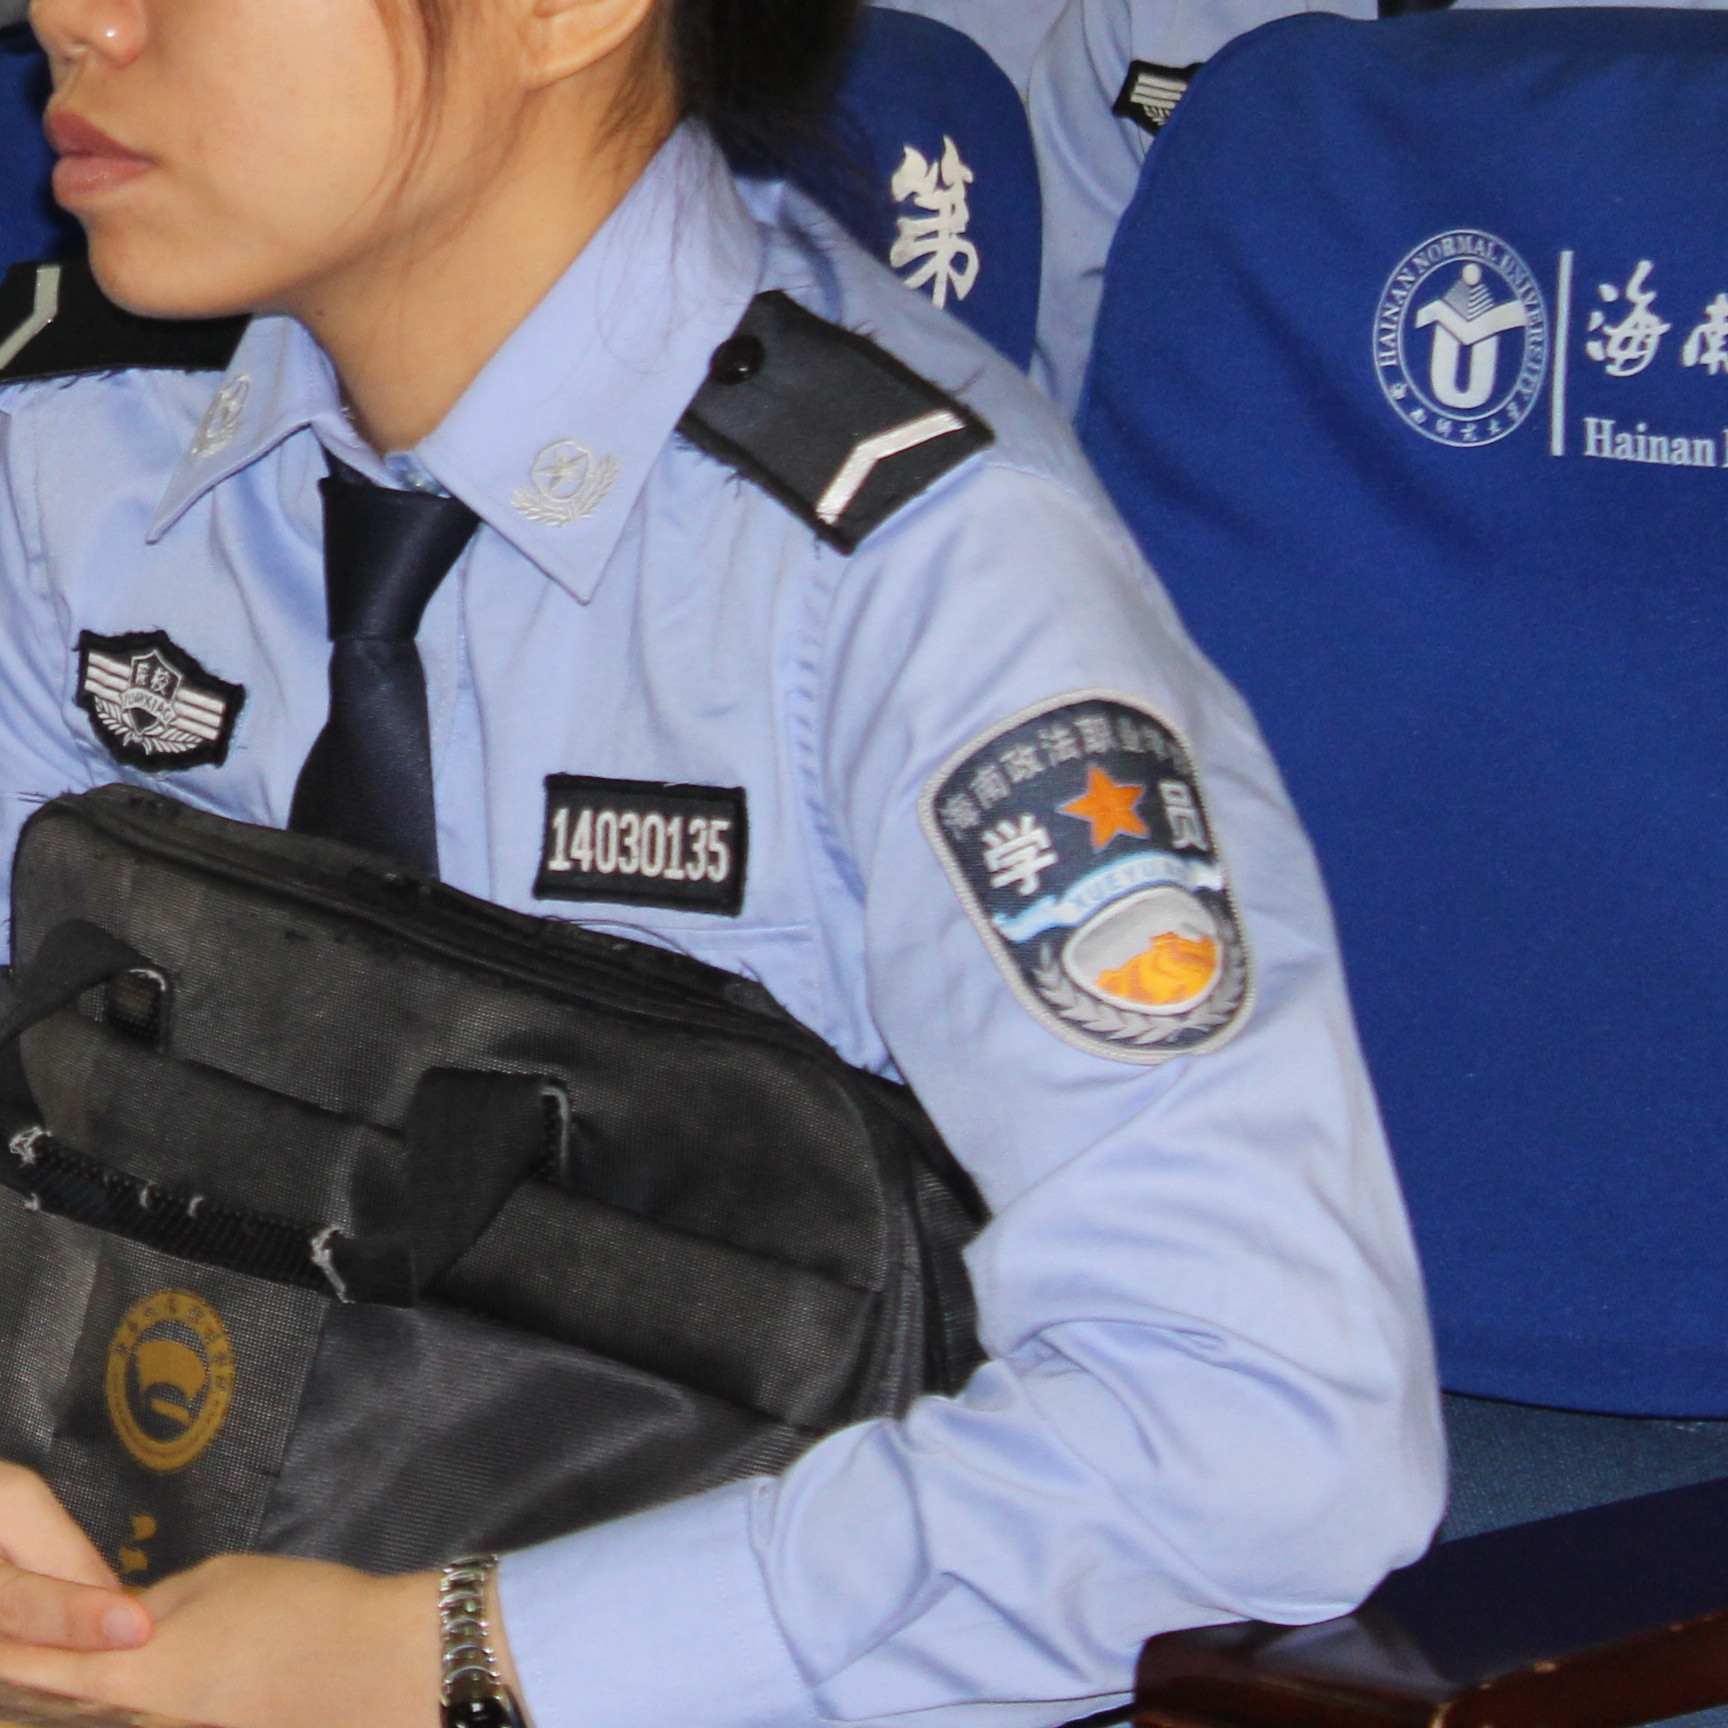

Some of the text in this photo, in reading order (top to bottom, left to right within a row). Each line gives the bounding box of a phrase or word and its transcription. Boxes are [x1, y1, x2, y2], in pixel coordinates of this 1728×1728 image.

[890, 136, 980, 310] 第
[1583, 417, 1717, 468] Hainan
[547, 807, 731, 883] 14030135
[981, 814, 1059, 897] 学
